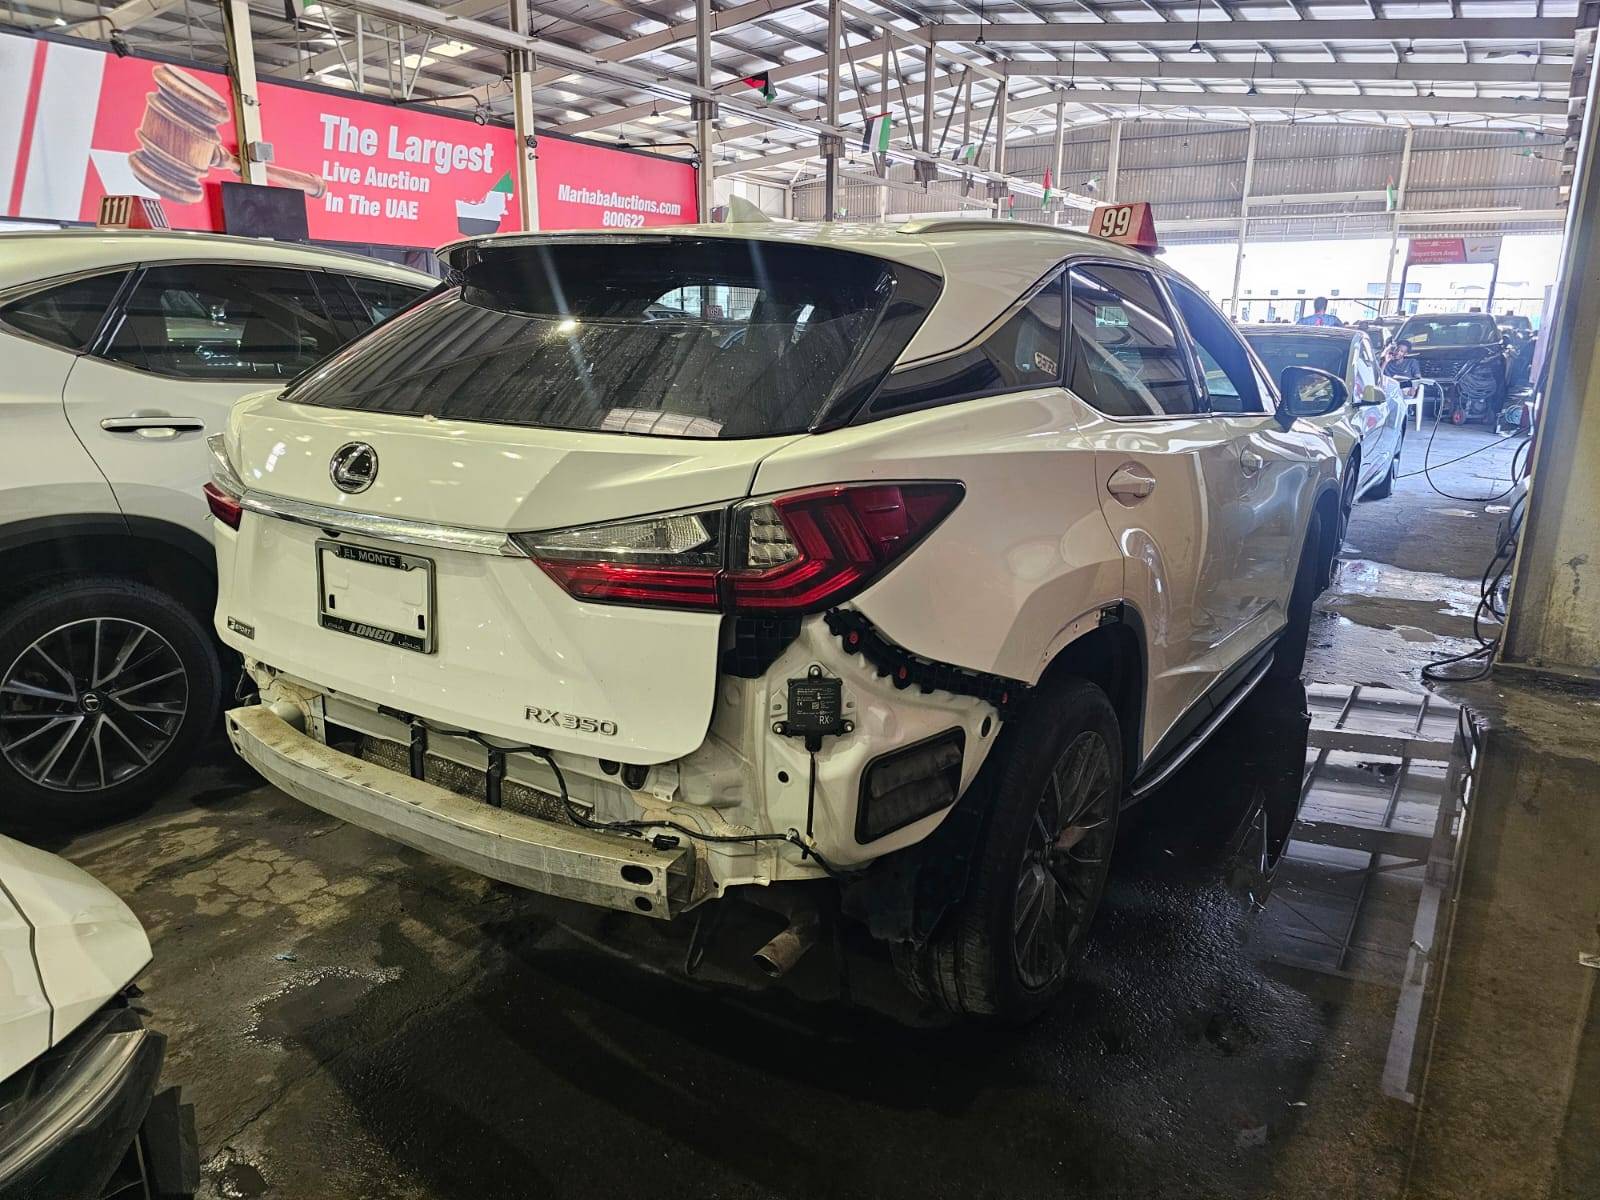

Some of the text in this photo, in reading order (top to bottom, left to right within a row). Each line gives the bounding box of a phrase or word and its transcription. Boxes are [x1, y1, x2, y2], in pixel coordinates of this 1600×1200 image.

[320, 113, 494, 174] The Largest
[322, 160, 430, 192] Live Auction
[104, 197, 127, 225] 111
[325, 192, 419, 220] In The UAE
[558, 183, 681, 216] MarhabaAuctions.com
[602, 210, 645, 228] 800622
[1100, 207, 1132, 237] 99
[343, 548, 396, 566] EL MONTE
[349, 622, 395, 643] LONGO
